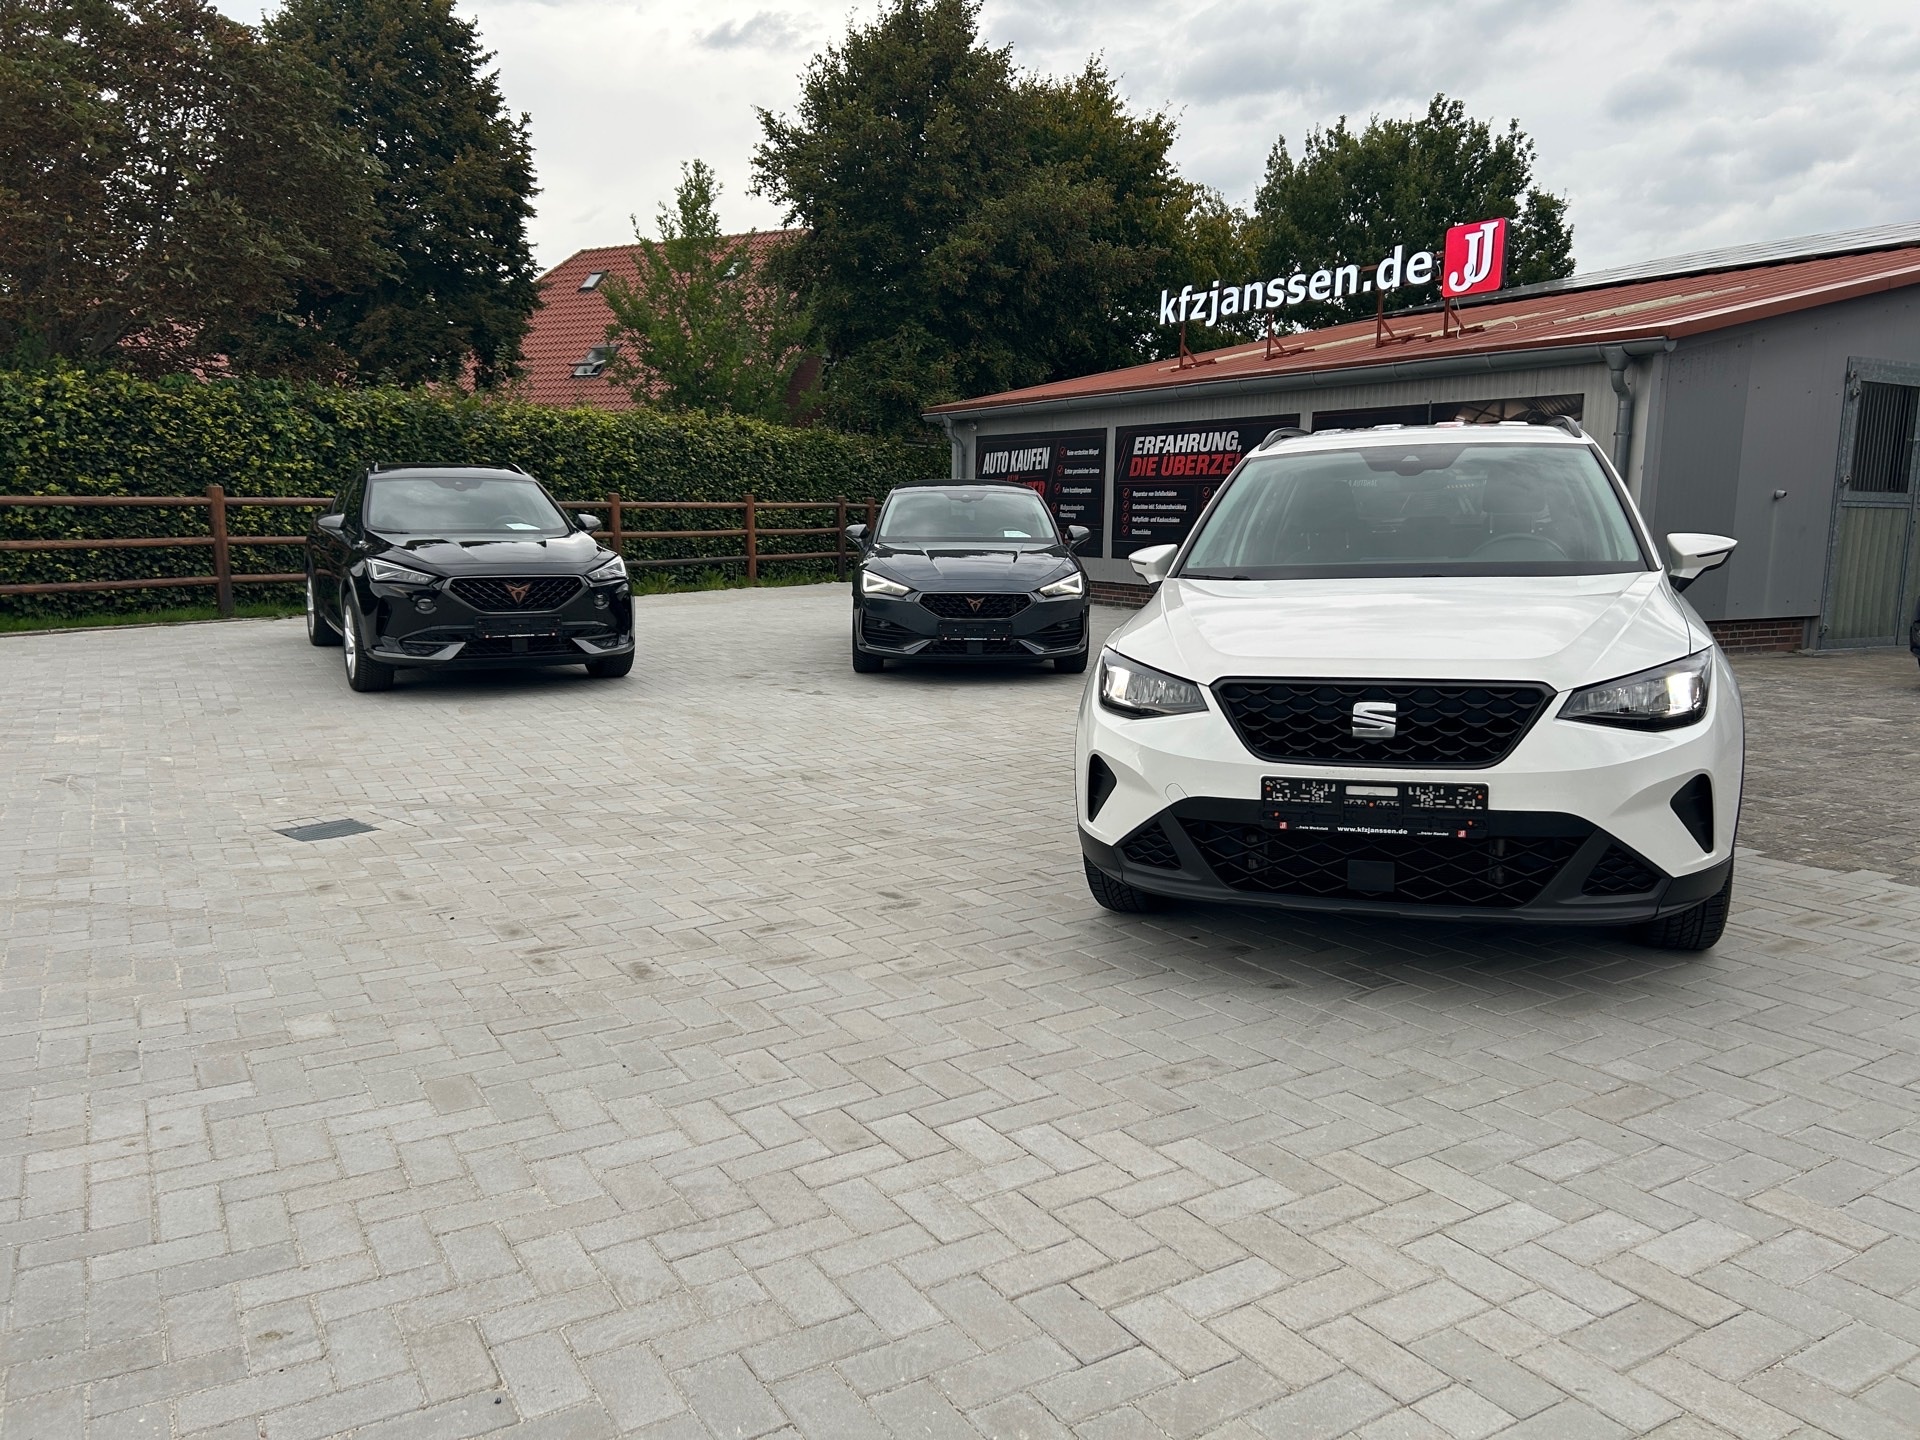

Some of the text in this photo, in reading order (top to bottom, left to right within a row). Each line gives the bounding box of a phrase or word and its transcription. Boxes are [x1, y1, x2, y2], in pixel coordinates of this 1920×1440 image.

[1159, 245, 1434, 327] kfzjanssen.de
[1133, 430, 1242, 455] ERFAHRUNG,
[982, 446, 1051, 475] AUTO KAUFEN
[1129, 455, 1159, 477] DIE
[1337, 826, 1408, 835] www.kfzjanssen.de
